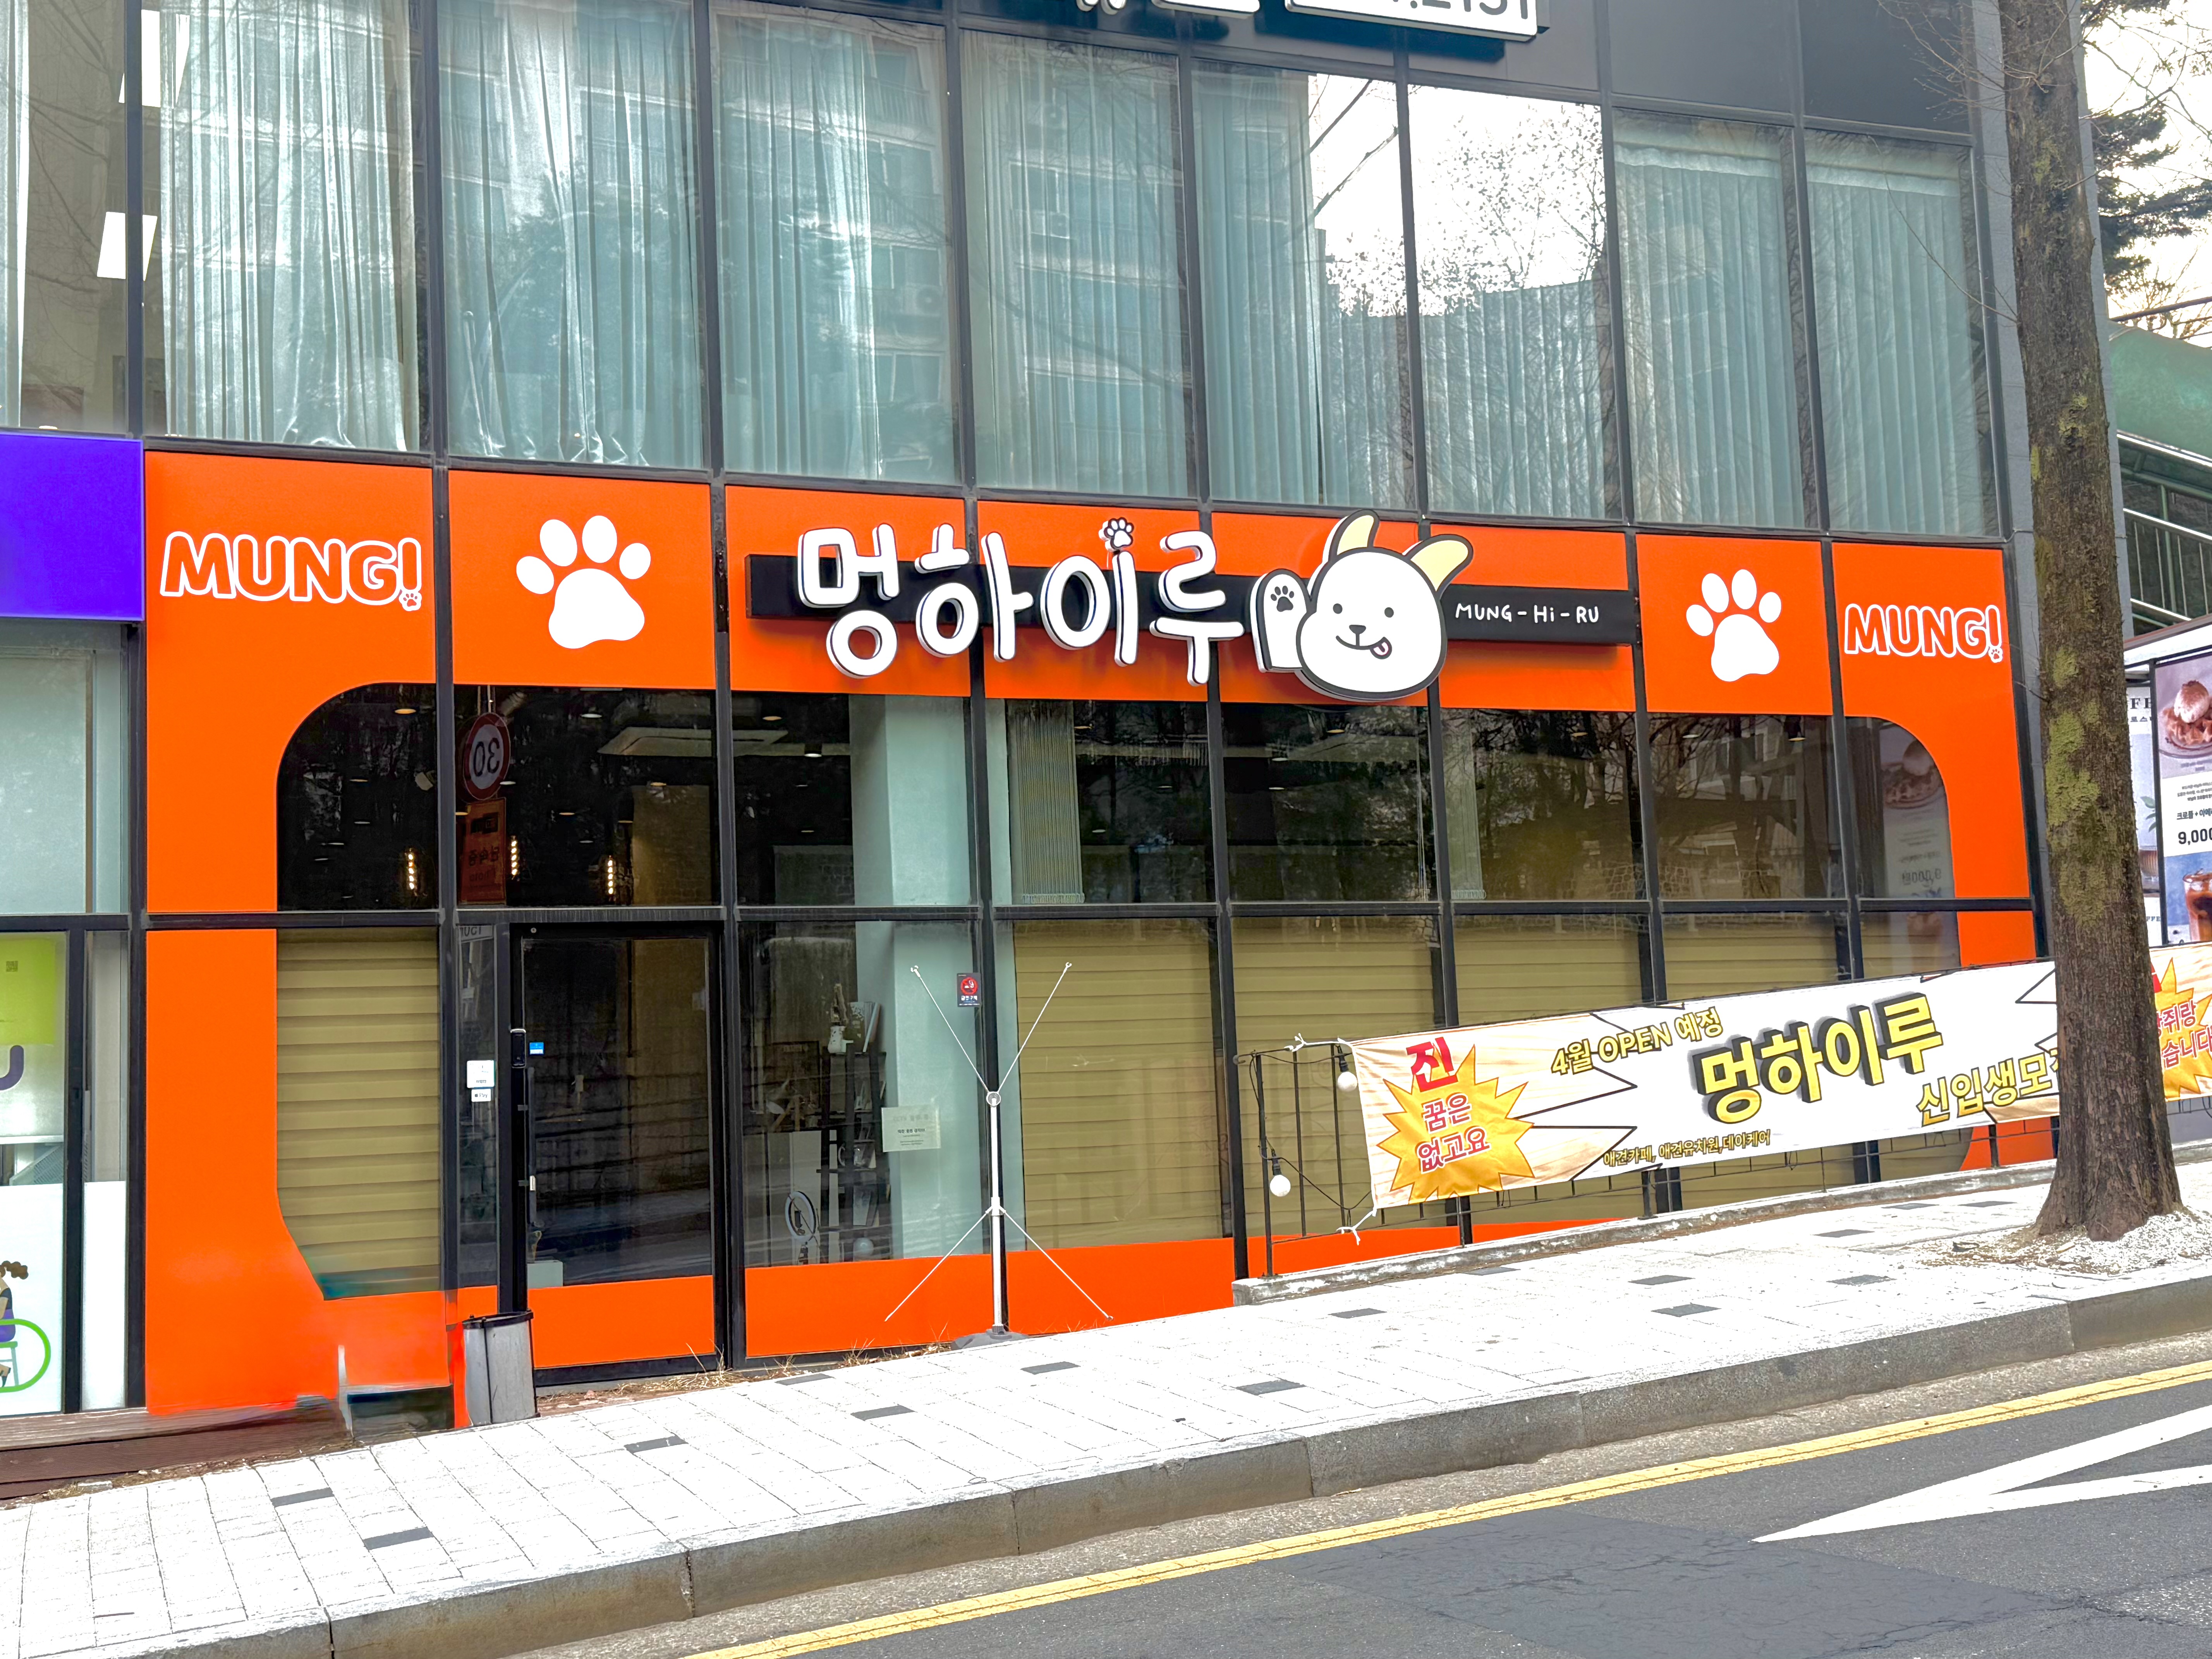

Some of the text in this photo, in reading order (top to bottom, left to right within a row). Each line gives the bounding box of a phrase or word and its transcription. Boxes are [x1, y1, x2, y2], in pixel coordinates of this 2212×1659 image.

[160, 531, 422, 611] MUNG!
[797, 518, 1244, 687] 멍하이루
[1844, 603, 2002, 663] MUNG!
[1406, 1037, 1458, 1092] 진
[1551, 1006, 1723, 1075] 4월 OPEN 예정
[1692, 993, 1943, 1124] 멍하이루
[1422, 1093, 1472, 1133] 꿈은
[1417, 1127, 1491, 1173] 없고요
[1604, 1146, 1656, 1167] 애견카페,
